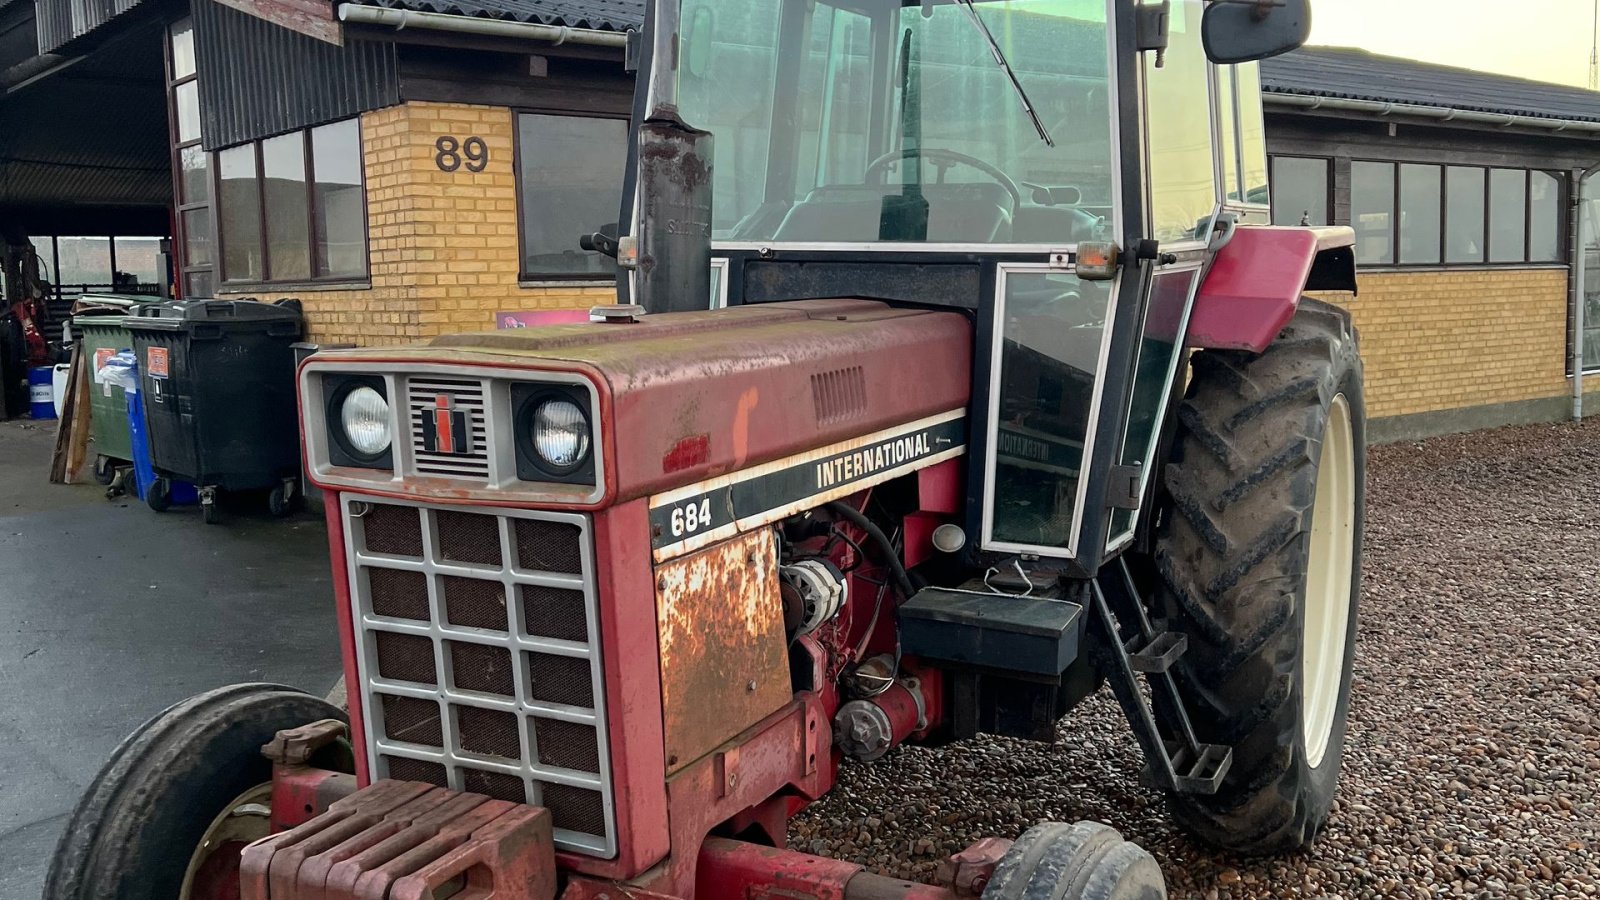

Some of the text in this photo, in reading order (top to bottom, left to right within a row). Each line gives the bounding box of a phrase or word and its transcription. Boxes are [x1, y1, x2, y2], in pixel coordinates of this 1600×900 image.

[435, 135, 488, 173] 89
[816, 431, 931, 489] INTERNATIONAL
[670, 497, 712, 537] 684
